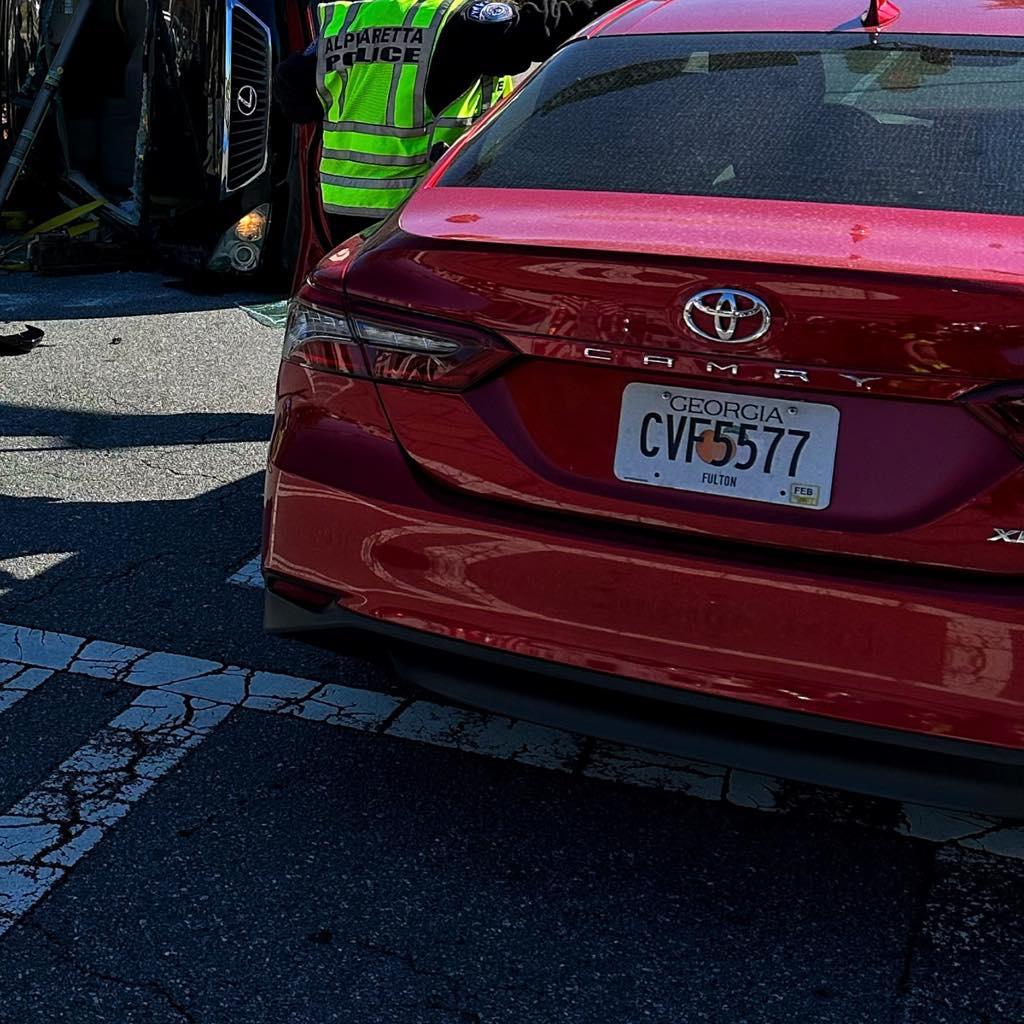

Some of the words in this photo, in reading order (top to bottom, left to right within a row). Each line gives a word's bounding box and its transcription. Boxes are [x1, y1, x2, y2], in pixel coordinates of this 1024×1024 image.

[584, 347, 881, 387] CAMRY
[670, 395, 784, 423] GEORGIA
[640, 412, 811, 477] CVF5577
[702, 473, 737, 487] FULTON
[794, 486, 813, 496] FEB
